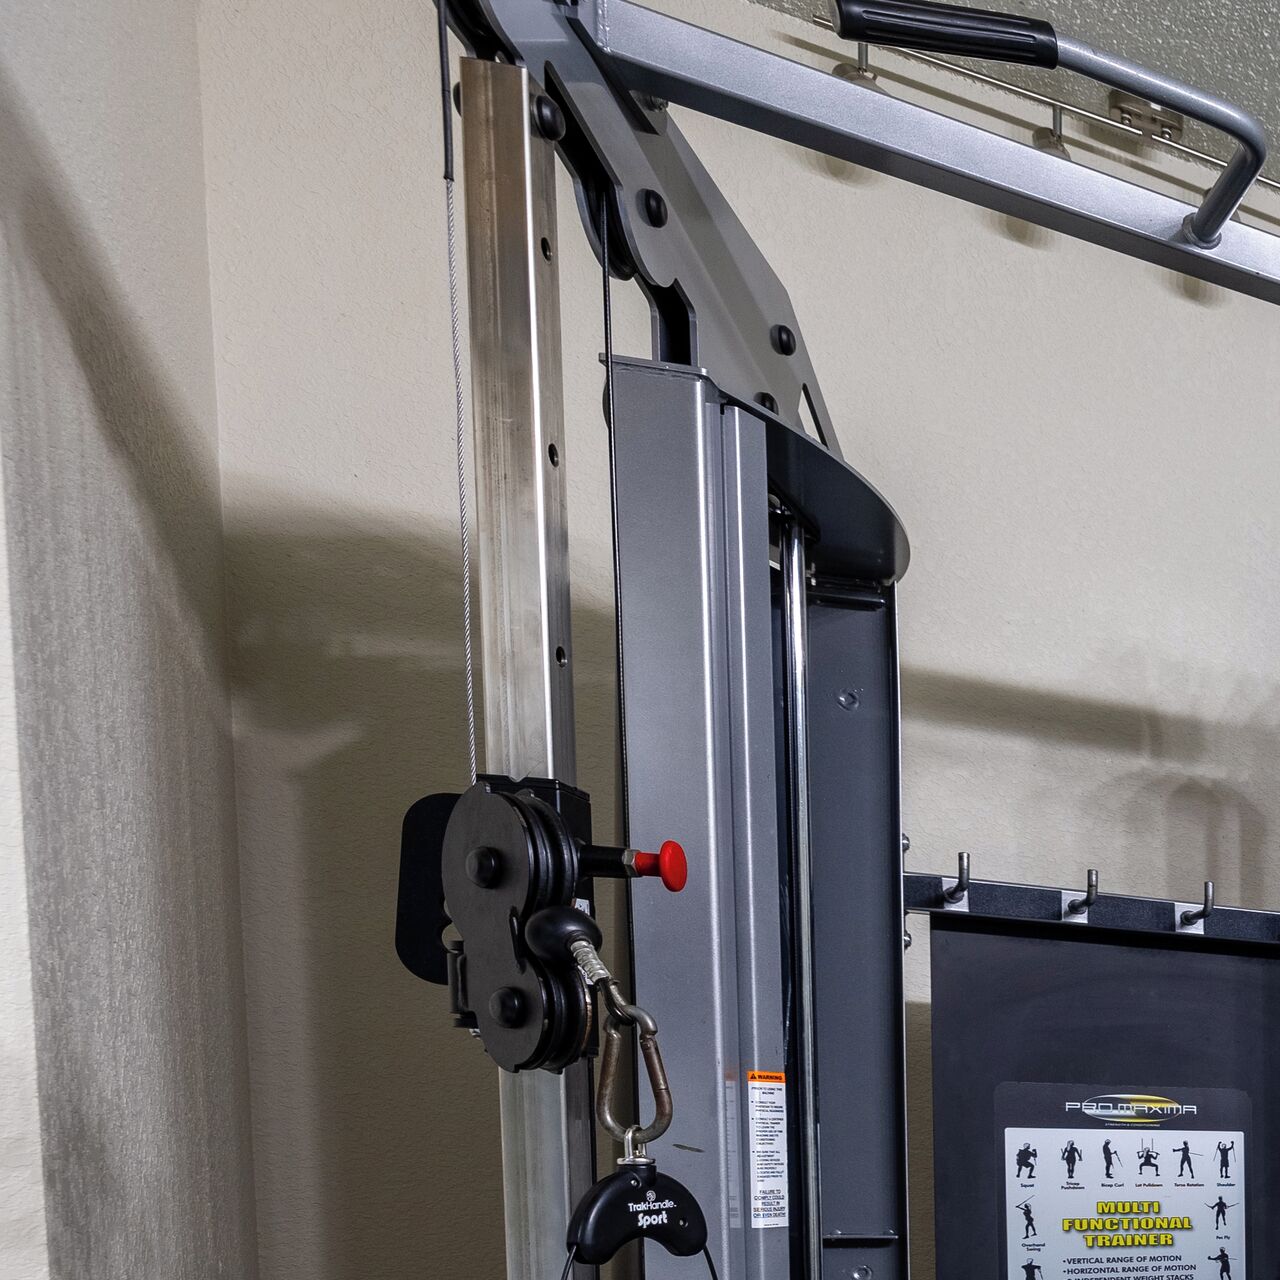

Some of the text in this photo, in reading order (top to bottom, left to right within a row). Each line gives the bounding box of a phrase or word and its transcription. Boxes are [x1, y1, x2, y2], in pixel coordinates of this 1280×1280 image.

[1096, 1201, 1161, 1214] MULTI
[638, 1211, 668, 1228] Sport
[1062, 1216, 1193, 1231] FUNCTIONAL
[1084, 1233, 1174, 1247] TRAINER
[1066, 1257, 1104, 1265] VERTICAL
[1106, 1256, 1134, 1264] RANGE
[1067, 1267, 1119, 1275] HORIZONTAL
